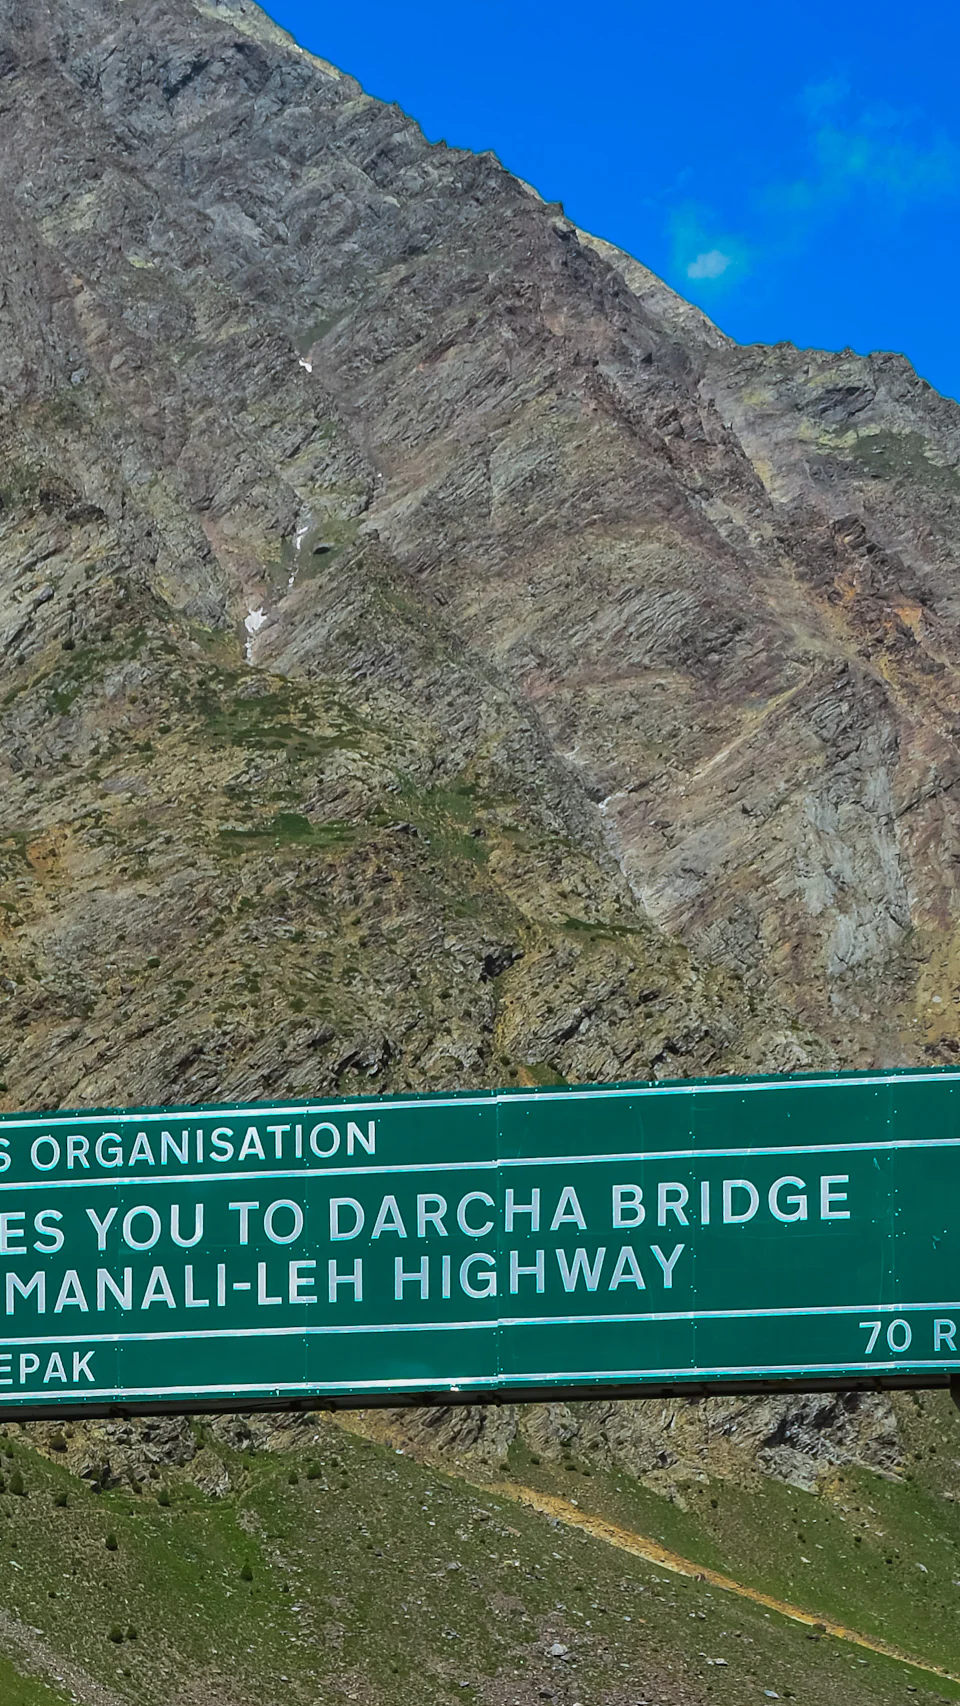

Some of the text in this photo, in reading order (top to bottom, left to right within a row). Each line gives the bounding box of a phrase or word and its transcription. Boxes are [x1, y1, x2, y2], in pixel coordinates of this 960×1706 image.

[29, 1119, 377, 1170] ORGANISATION
[84, 1202, 205, 1251] YOU
[227, 1198, 305, 1245] TO
[328, 1185, 588, 1241] DARCHA
[611, 1173, 852, 1228] BRIDGE
[4, 1257, 364, 1315] MANALI-LEH
[393, 1242, 686, 1301] HIGHWAY
[858, 1317, 913, 1354] 70
